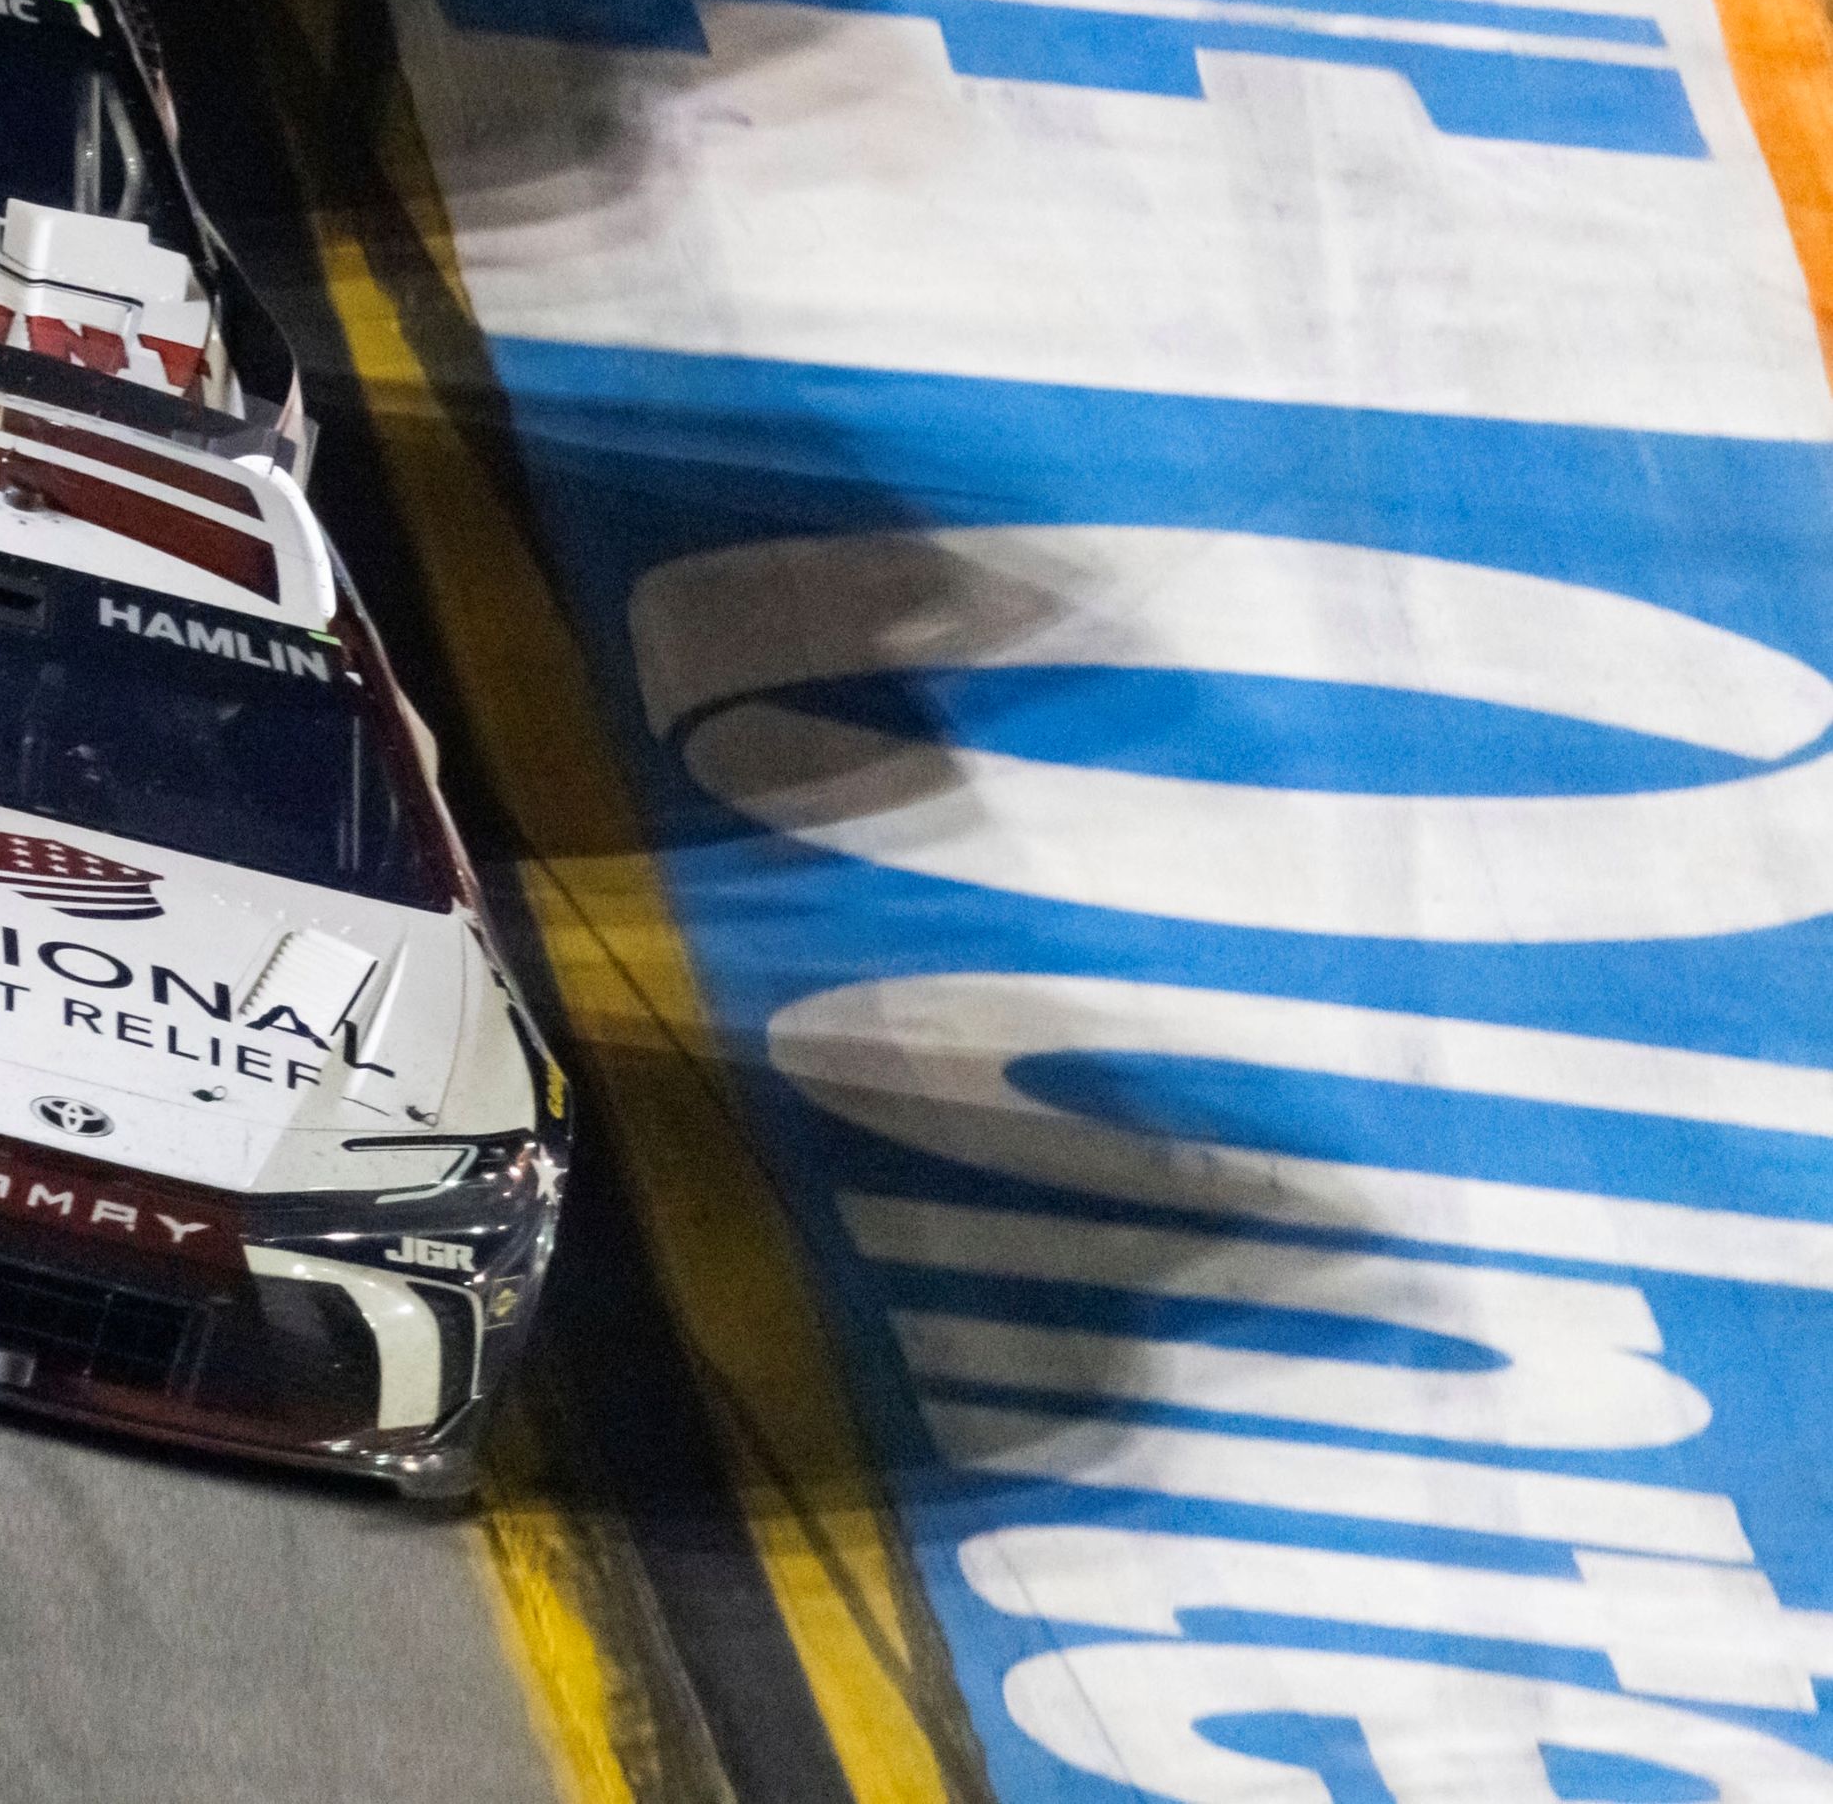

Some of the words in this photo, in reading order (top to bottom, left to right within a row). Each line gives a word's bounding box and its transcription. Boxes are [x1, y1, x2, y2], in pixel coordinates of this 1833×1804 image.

[100, 597, 331, 682] HAMLIN
[64, 998, 328, 1091] RELIEF
[384, 1236, 476, 1273] JGR
